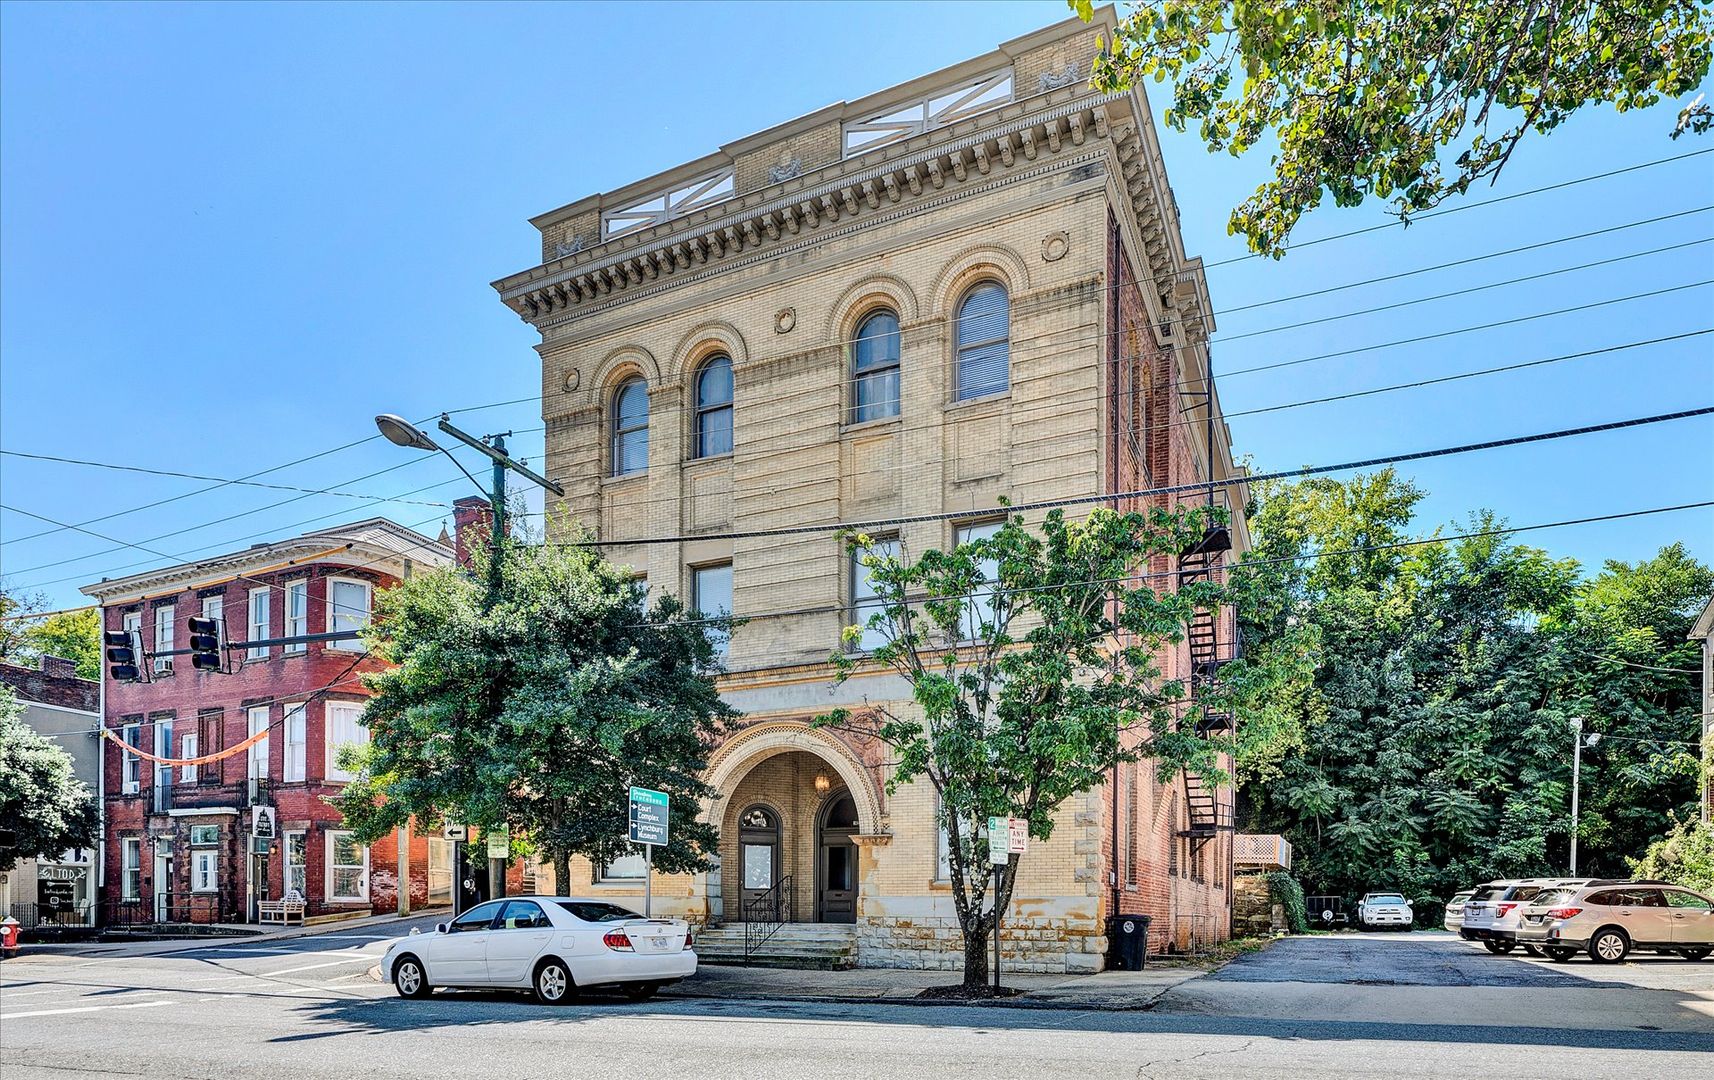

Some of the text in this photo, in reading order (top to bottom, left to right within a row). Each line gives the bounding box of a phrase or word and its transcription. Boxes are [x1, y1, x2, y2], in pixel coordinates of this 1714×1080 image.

[637, 803, 652, 813] Court
[637, 812, 660, 822] Complex
[990, 818, 995, 829] 2
[637, 823, 664, 835] Lynchburg
[637, 831, 657, 840] Museum
[1011, 838, 1025, 846] TIME
